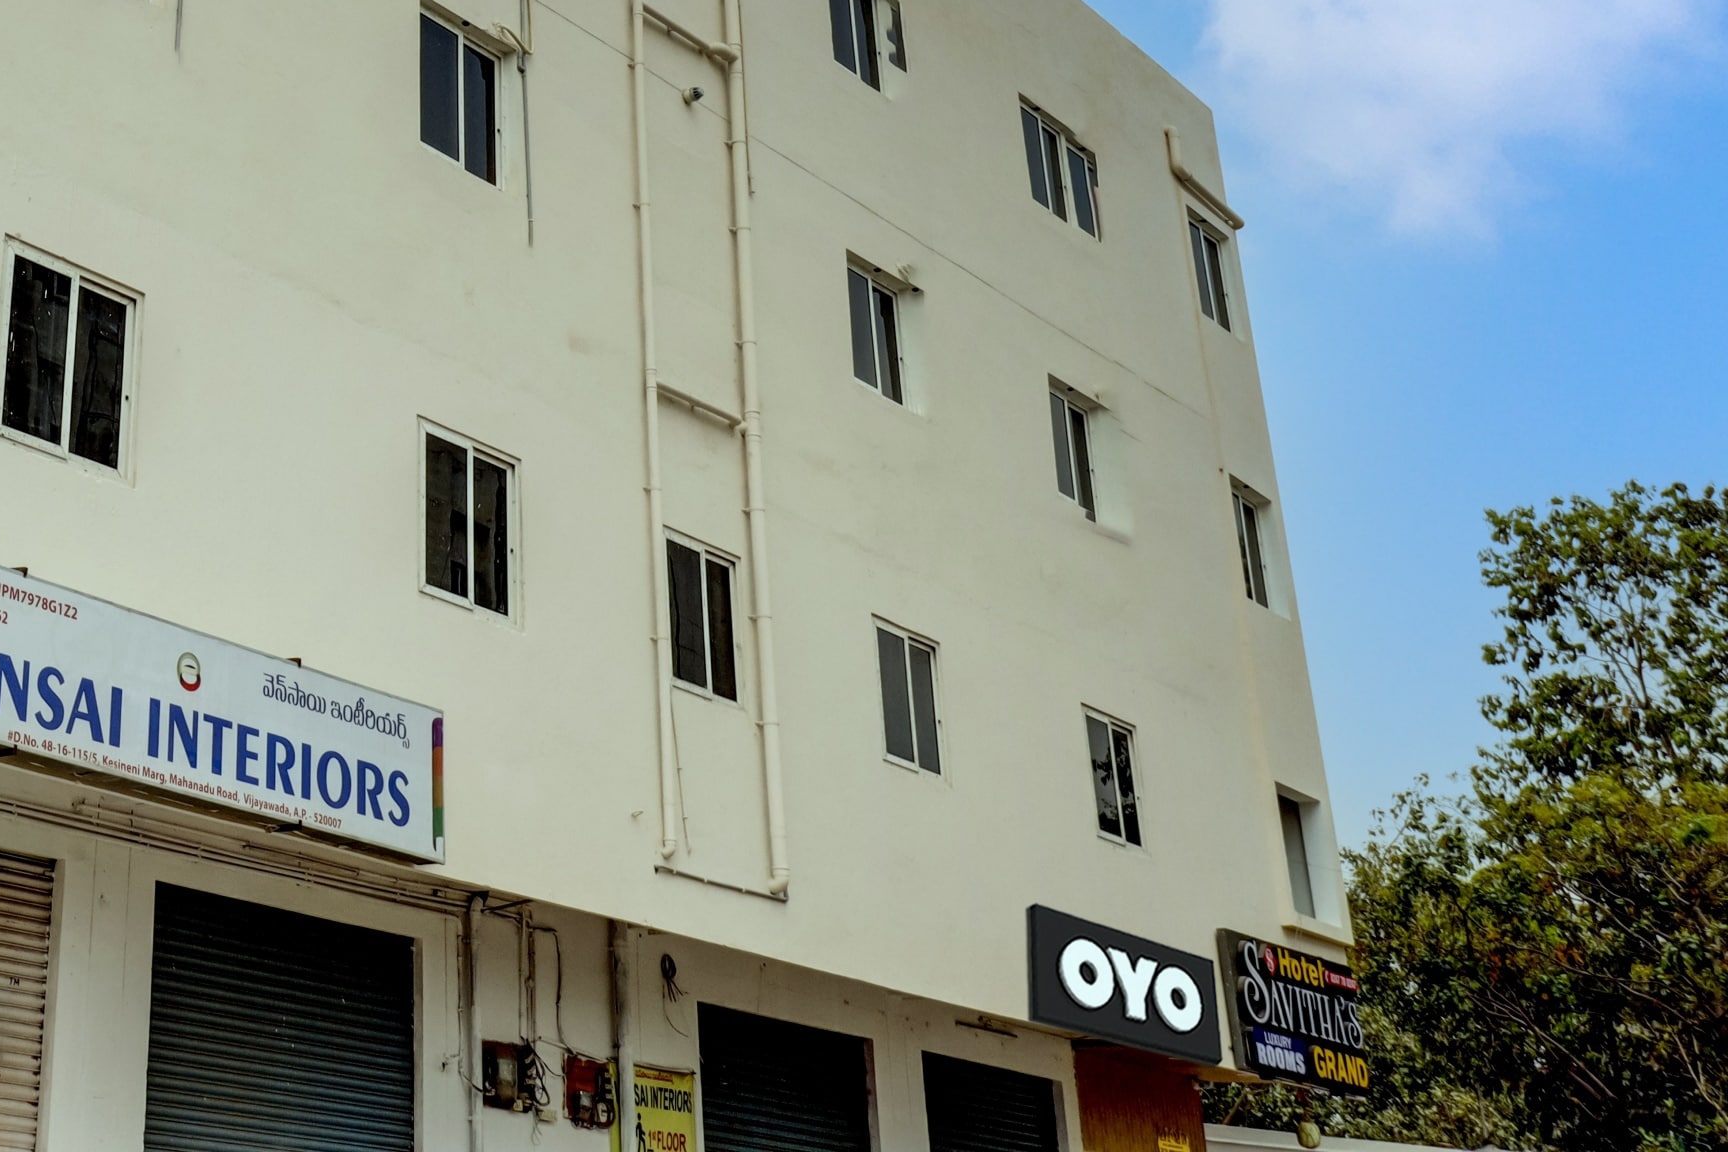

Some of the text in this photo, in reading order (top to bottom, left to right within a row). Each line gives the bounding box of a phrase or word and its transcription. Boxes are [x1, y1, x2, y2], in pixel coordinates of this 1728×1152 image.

[147, 697, 410, 827] INTERIORS
[102, 755, 140, 776] Kesineni
[142, 766, 167, 785] Marg,
[169, 773, 215, 796] Mahanadu
[217, 786, 240, 804] Road,
[243, 793, 292, 818] Vijayawada,
[293, 807, 308, 820] A.P.
[314, 812, 342, 830] 520007
[1059, 937, 1203, 1033] OYO
[1277, 947, 1325, 988] Hotel
[1256, 1041, 1306, 1075] ROOMS
[1264, 1031, 1292, 1049] LUXURY
[1313, 1046, 1370, 1088] GRAND
[651, 1086, 693, 1114] INTERIORS
[657, 1130, 687, 1152] FLOOR
